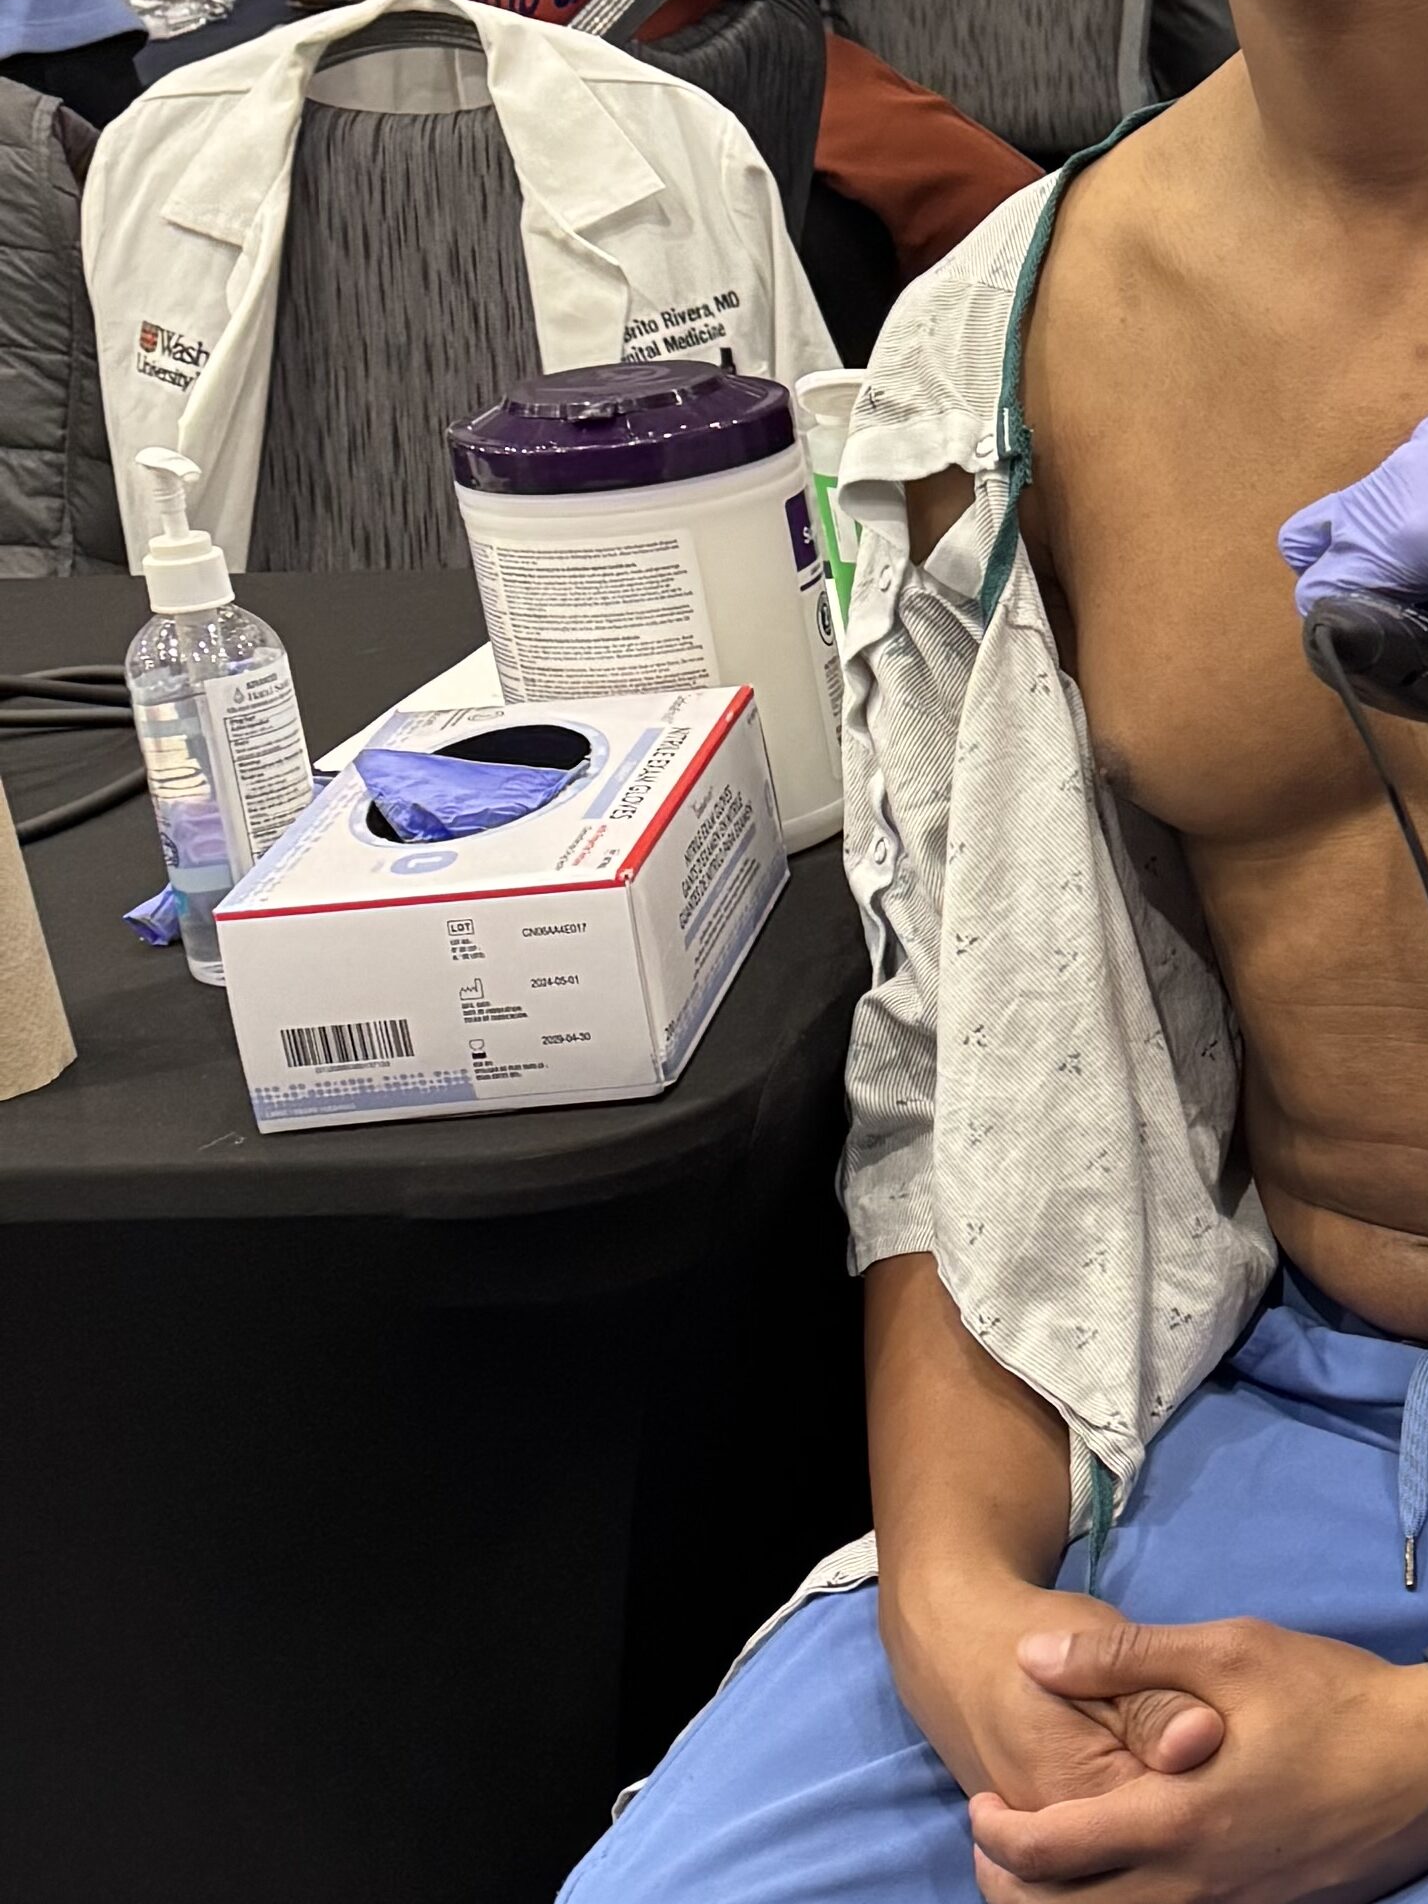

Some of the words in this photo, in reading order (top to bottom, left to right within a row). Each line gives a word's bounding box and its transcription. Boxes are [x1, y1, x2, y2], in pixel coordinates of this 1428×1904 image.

[713, 290, 741, 313] MD
[663, 322, 727, 354] Medicine
[136, 352, 195, 393] University
[653, 726, 693, 758] NITRILE
[639, 759, 671, 784] EXAM
[609, 784, 652, 820] GLOVES
[450, 921, 471, 934] LOT
